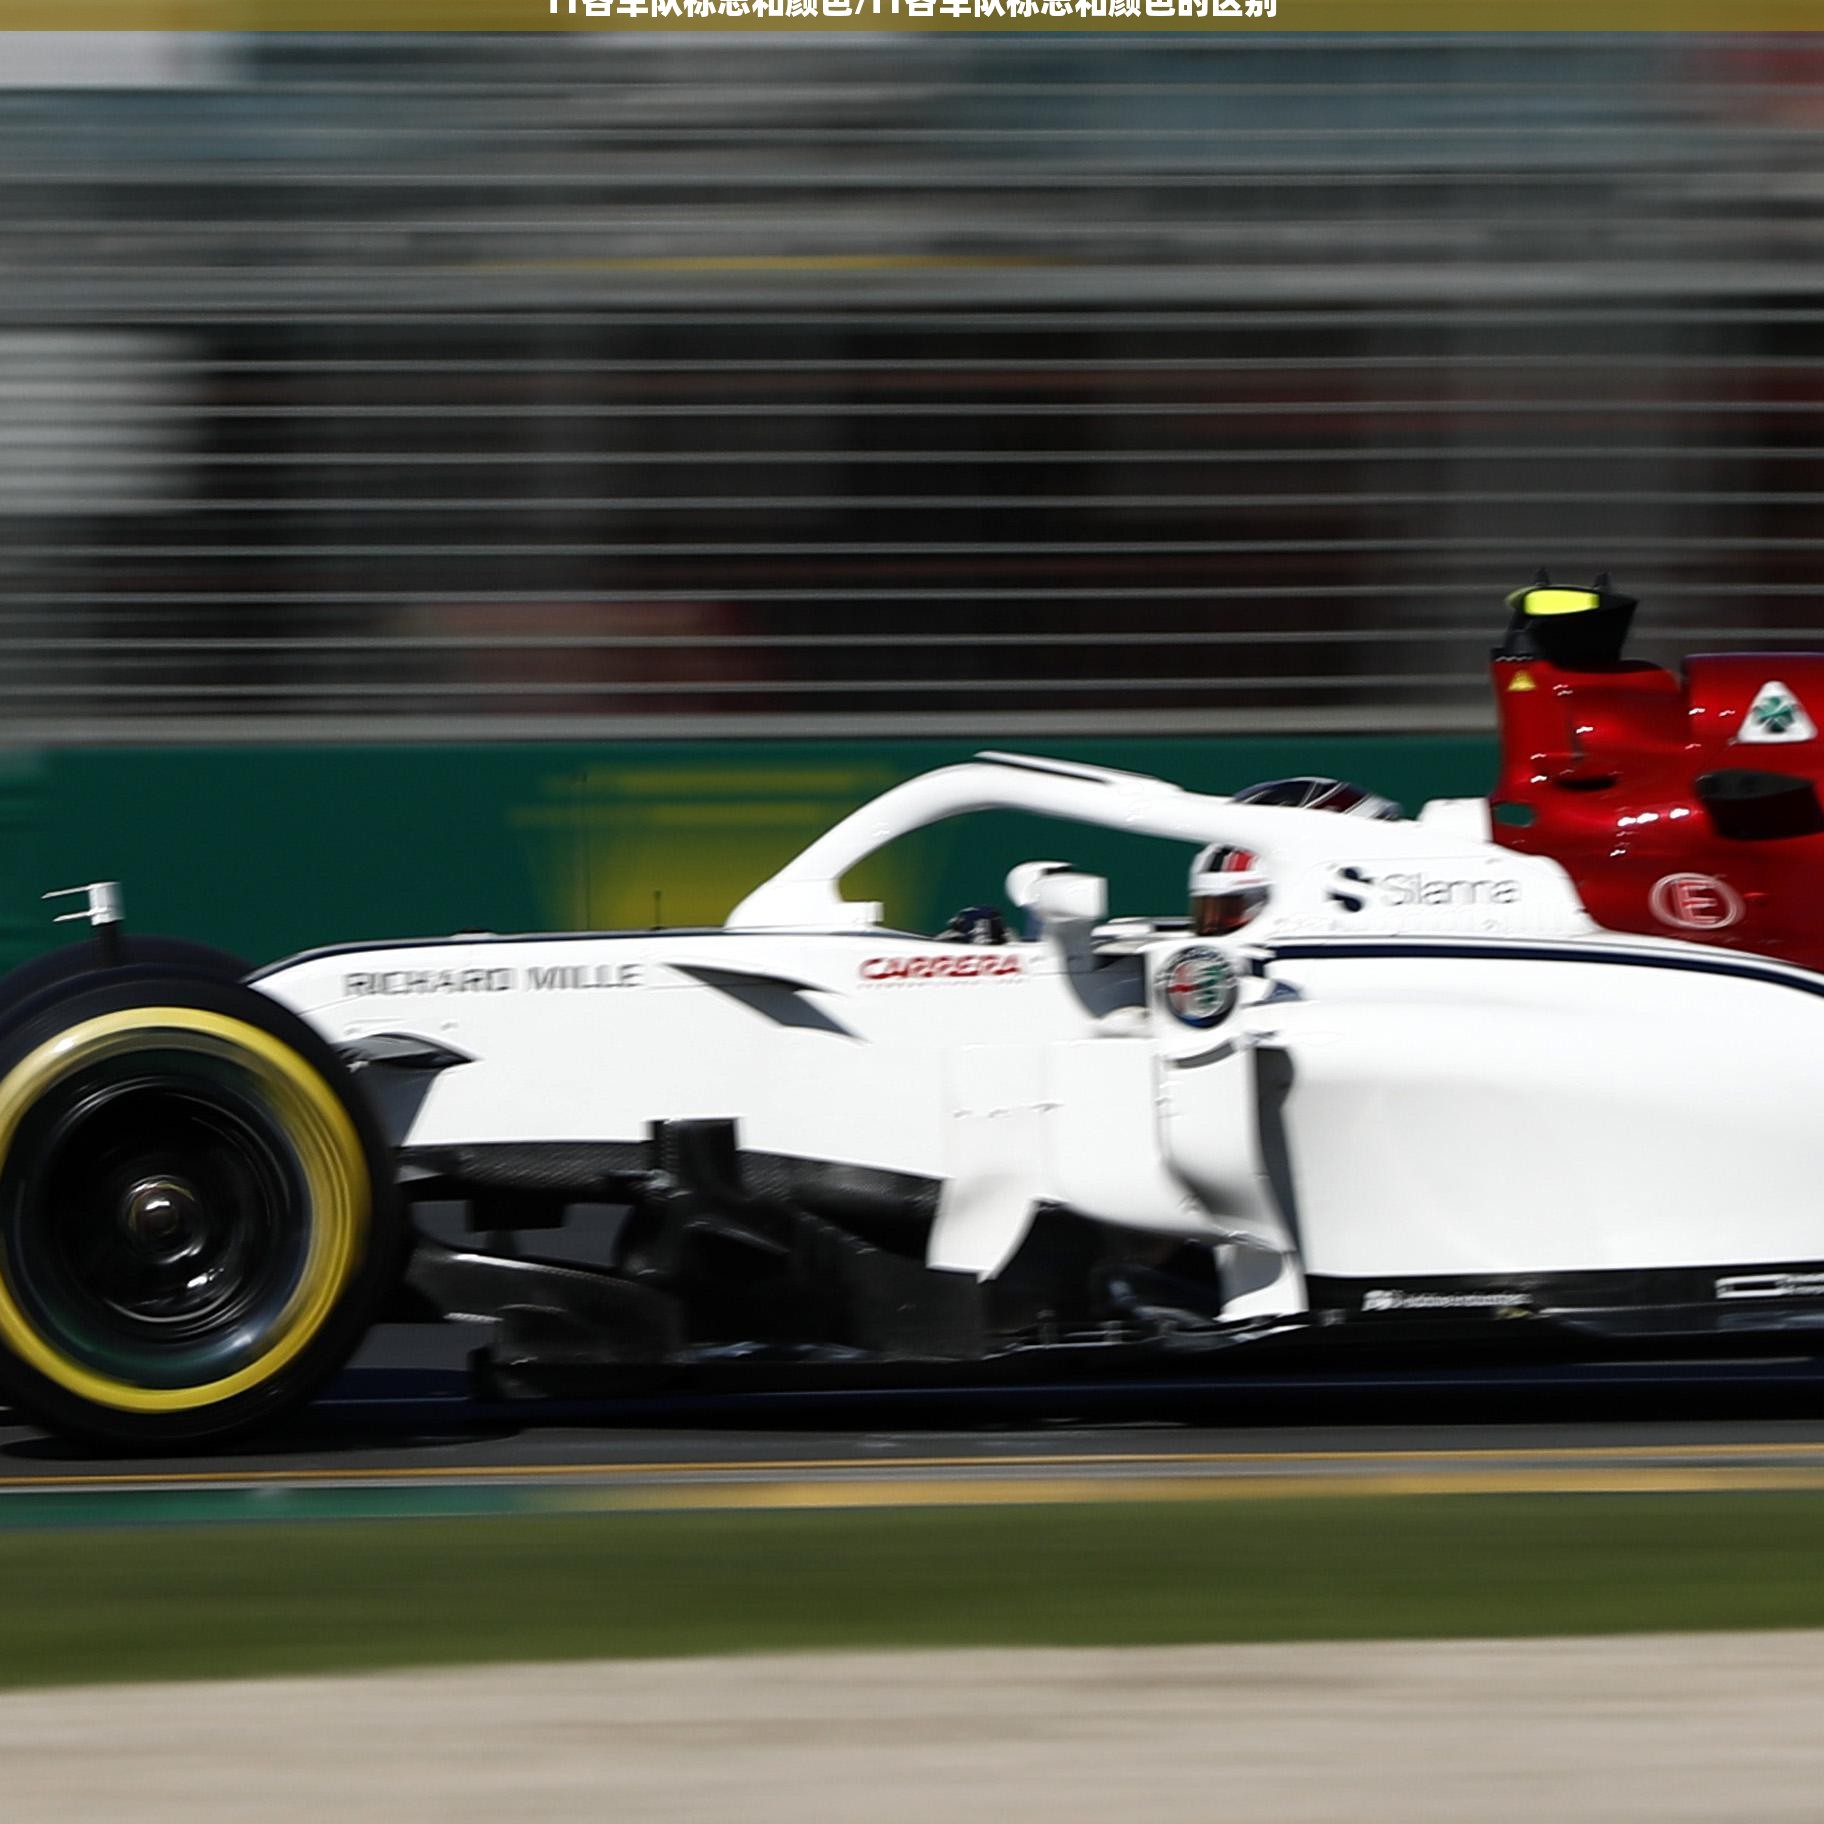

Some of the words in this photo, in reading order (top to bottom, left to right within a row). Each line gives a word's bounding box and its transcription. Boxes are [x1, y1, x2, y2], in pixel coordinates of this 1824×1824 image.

[344, 967, 516, 995] RICHARD
[526, 963, 643, 990] MILLE
[860, 955, 1022, 980] CARRERA
